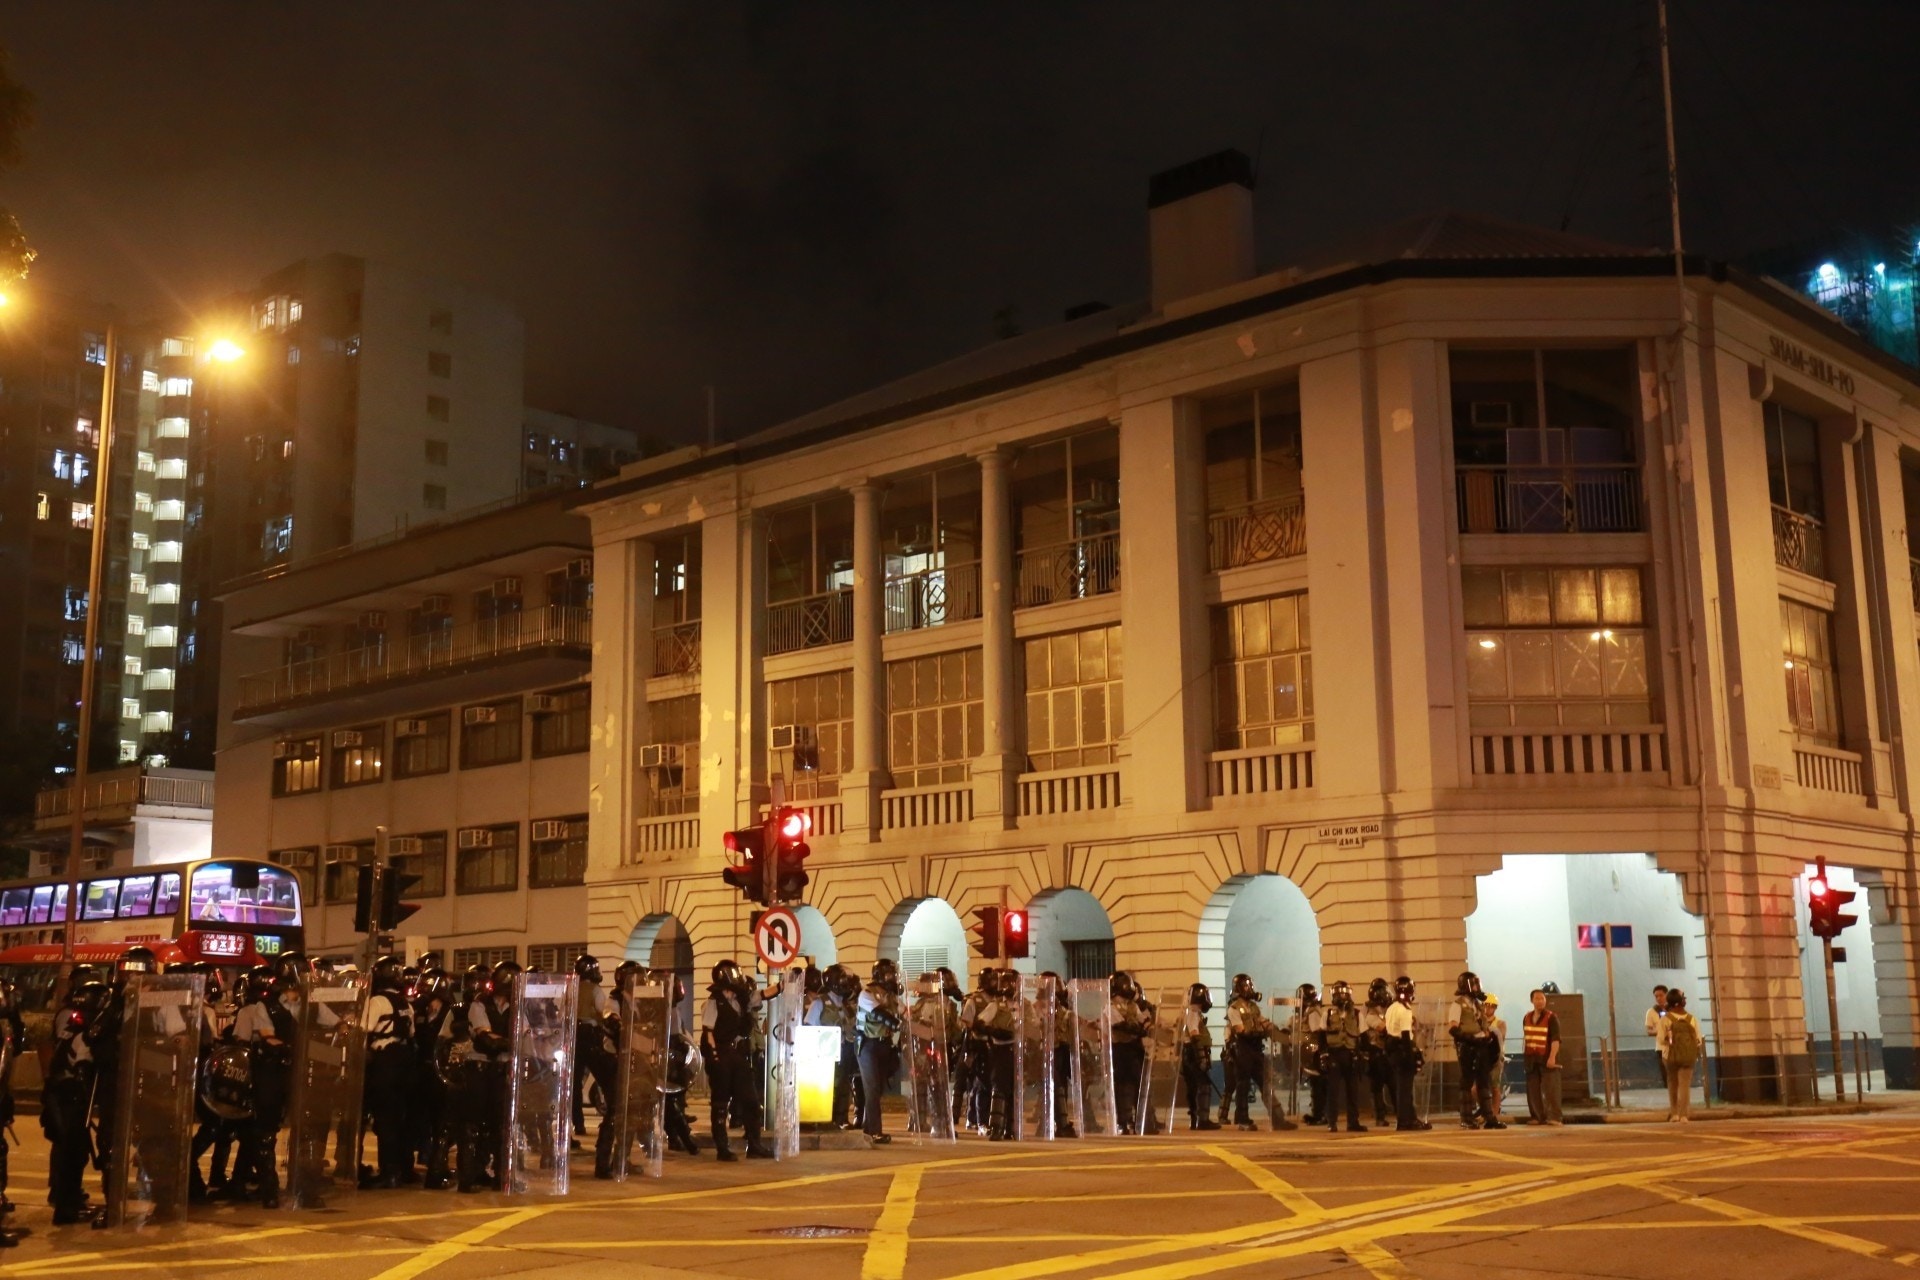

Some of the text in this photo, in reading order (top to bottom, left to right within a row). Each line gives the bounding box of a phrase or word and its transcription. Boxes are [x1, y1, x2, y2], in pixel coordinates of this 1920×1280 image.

[1319, 824, 1379, 837] LAI CHI KOK ROAD
[255, 935, 280, 954] 31B
